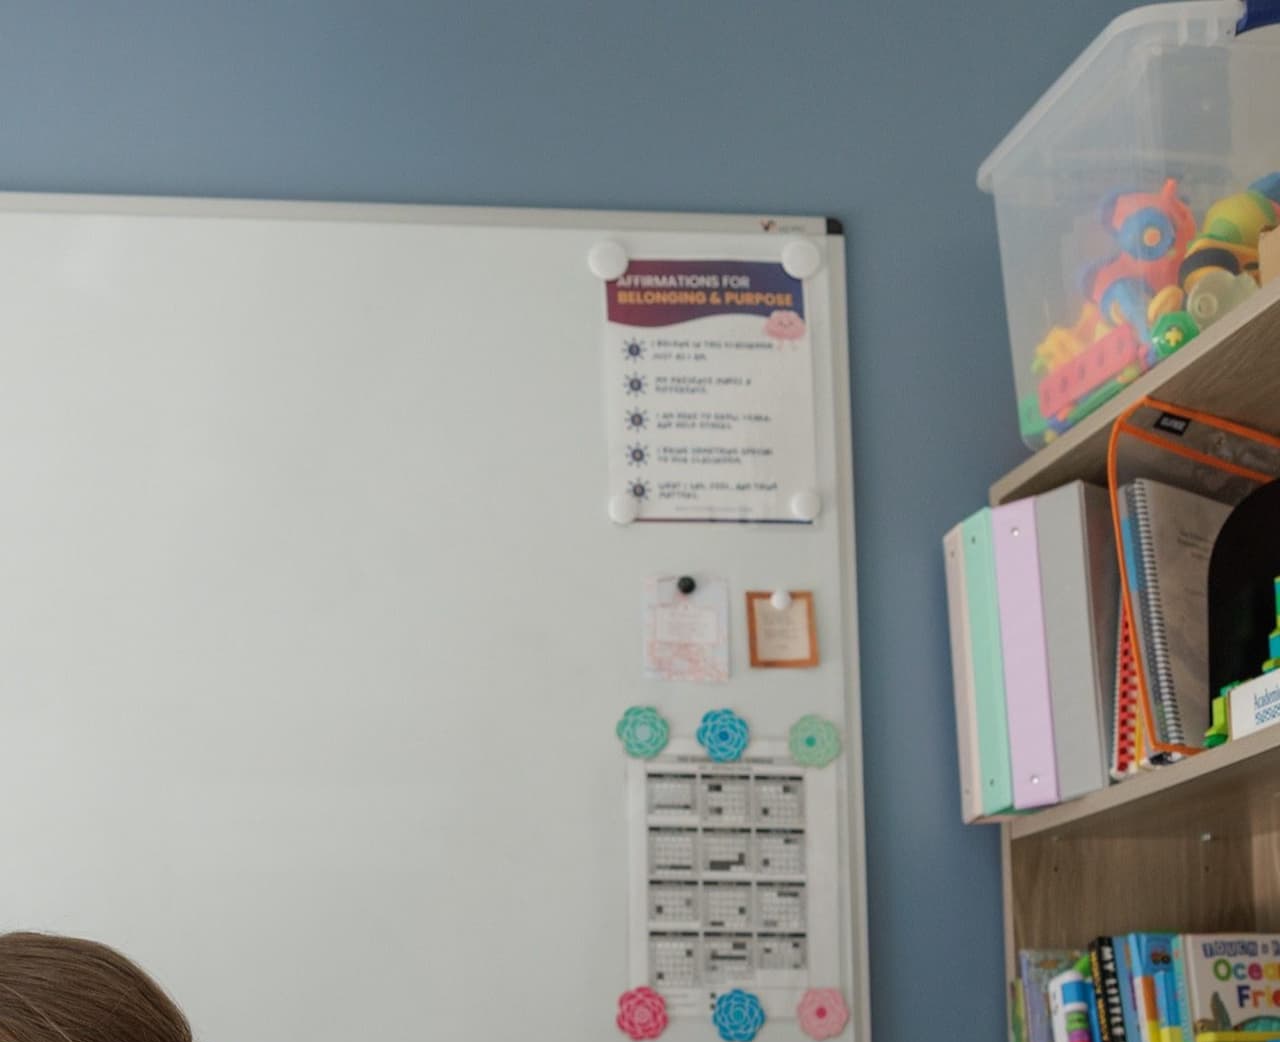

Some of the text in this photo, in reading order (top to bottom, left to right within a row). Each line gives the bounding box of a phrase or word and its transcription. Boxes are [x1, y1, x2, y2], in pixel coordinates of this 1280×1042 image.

[616, 274, 751, 289] AFFIRMATIONS FOR
[617, 290, 793, 307] BELONGING & PURPOSE
[1100, 945, 1116, 973] MY
[1104, 977, 1126, 1037] LITTLE
